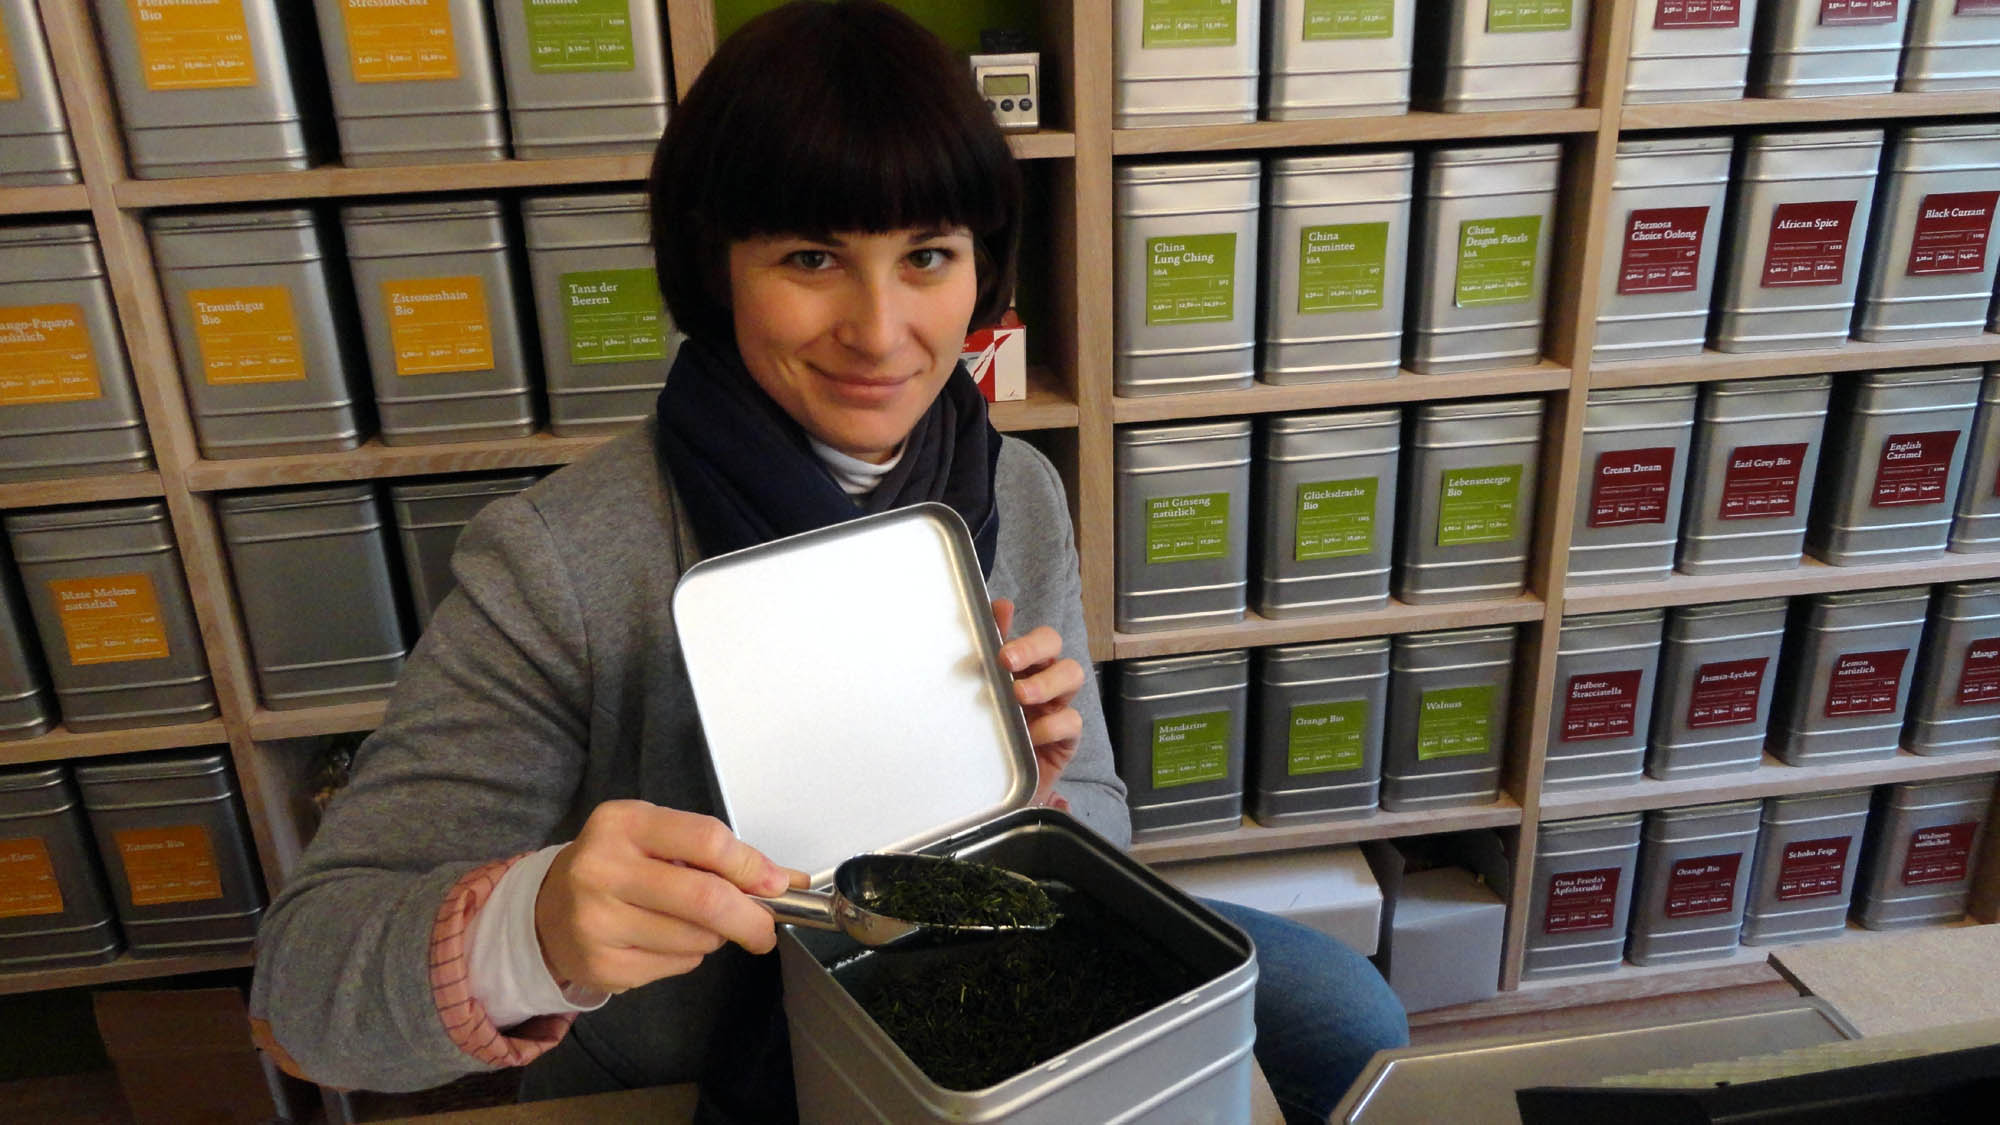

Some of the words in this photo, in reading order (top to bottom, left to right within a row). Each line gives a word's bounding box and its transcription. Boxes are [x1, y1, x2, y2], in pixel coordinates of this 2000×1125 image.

[140, 9, 162, 21] Bio
[1925, 209, 1950, 219] Black
[1951, 208, 1986, 217] Currant
[1633, 220, 1672, 230] Formosa
[1777, 220, 1812, 229] African
[1814, 218, 1839, 230] Spice
[1467, 226, 1496, 235] China
[1631, 231, 1662, 241] Choice
[1664, 230, 1697, 240] Oolong
[1308, 232, 1339, 241] China
[1466, 237, 1499, 248] Dragon
[1501, 233, 1529, 244] Pearls
[1154, 243, 1185, 253] China
[1307, 243, 1355, 255] Jasmintee
[1154, 255, 1181, 266] Lung
[1183, 253, 1215, 264] Ching
[569, 284, 598, 294] Tanz
[600, 282, 619, 293] der
[391, 290, 469, 304] Zitronenhain
[571, 296, 611, 306] Beeren
[196, 301, 265, 313] Traumfigur
[395, 305, 414, 316] Bio
[201, 313, 222, 325] Bio
[1889, 441, 1922, 453] English
[1886, 450, 1922, 460] Caramel
[1734, 460, 1752, 469] Earl
[1753, 459, 1775, 469] Grey
[1776, 457, 1791, 466] Bio
[1603, 466, 1631, 475] Cream
[1633, 464, 1662, 473] Dream
[1304, 488, 1365, 501] Glücksdrache
[1447, 488, 1462, 497] Bio
[1153, 501, 1169, 509] mit
[1171, 497, 1210, 508] Ginseng
[1303, 501, 1318, 510] Bio
[1152, 507, 1196, 519] natürlich
[1841, 660, 1868, 668] Lemon
[1838, 666, 1875, 676] natürlich
[1574, 682, 1608, 690] Erdbeer-
[1572, 687, 1622, 699] Stracciatella
[1295, 718, 1328, 726] Orange
[1329, 714, 1344, 723] Bio
[1159, 723, 1208, 734] Mandarine
[1159, 733, 1185, 744] Kokos
[1788, 849, 1816, 859] Schoko
[1817, 848, 1838, 857] Feige
[1677, 868, 1705, 876] Orange
[1706, 865, 1720, 873] Bio
[1553, 884, 1603, 896] Apfelstrudel
